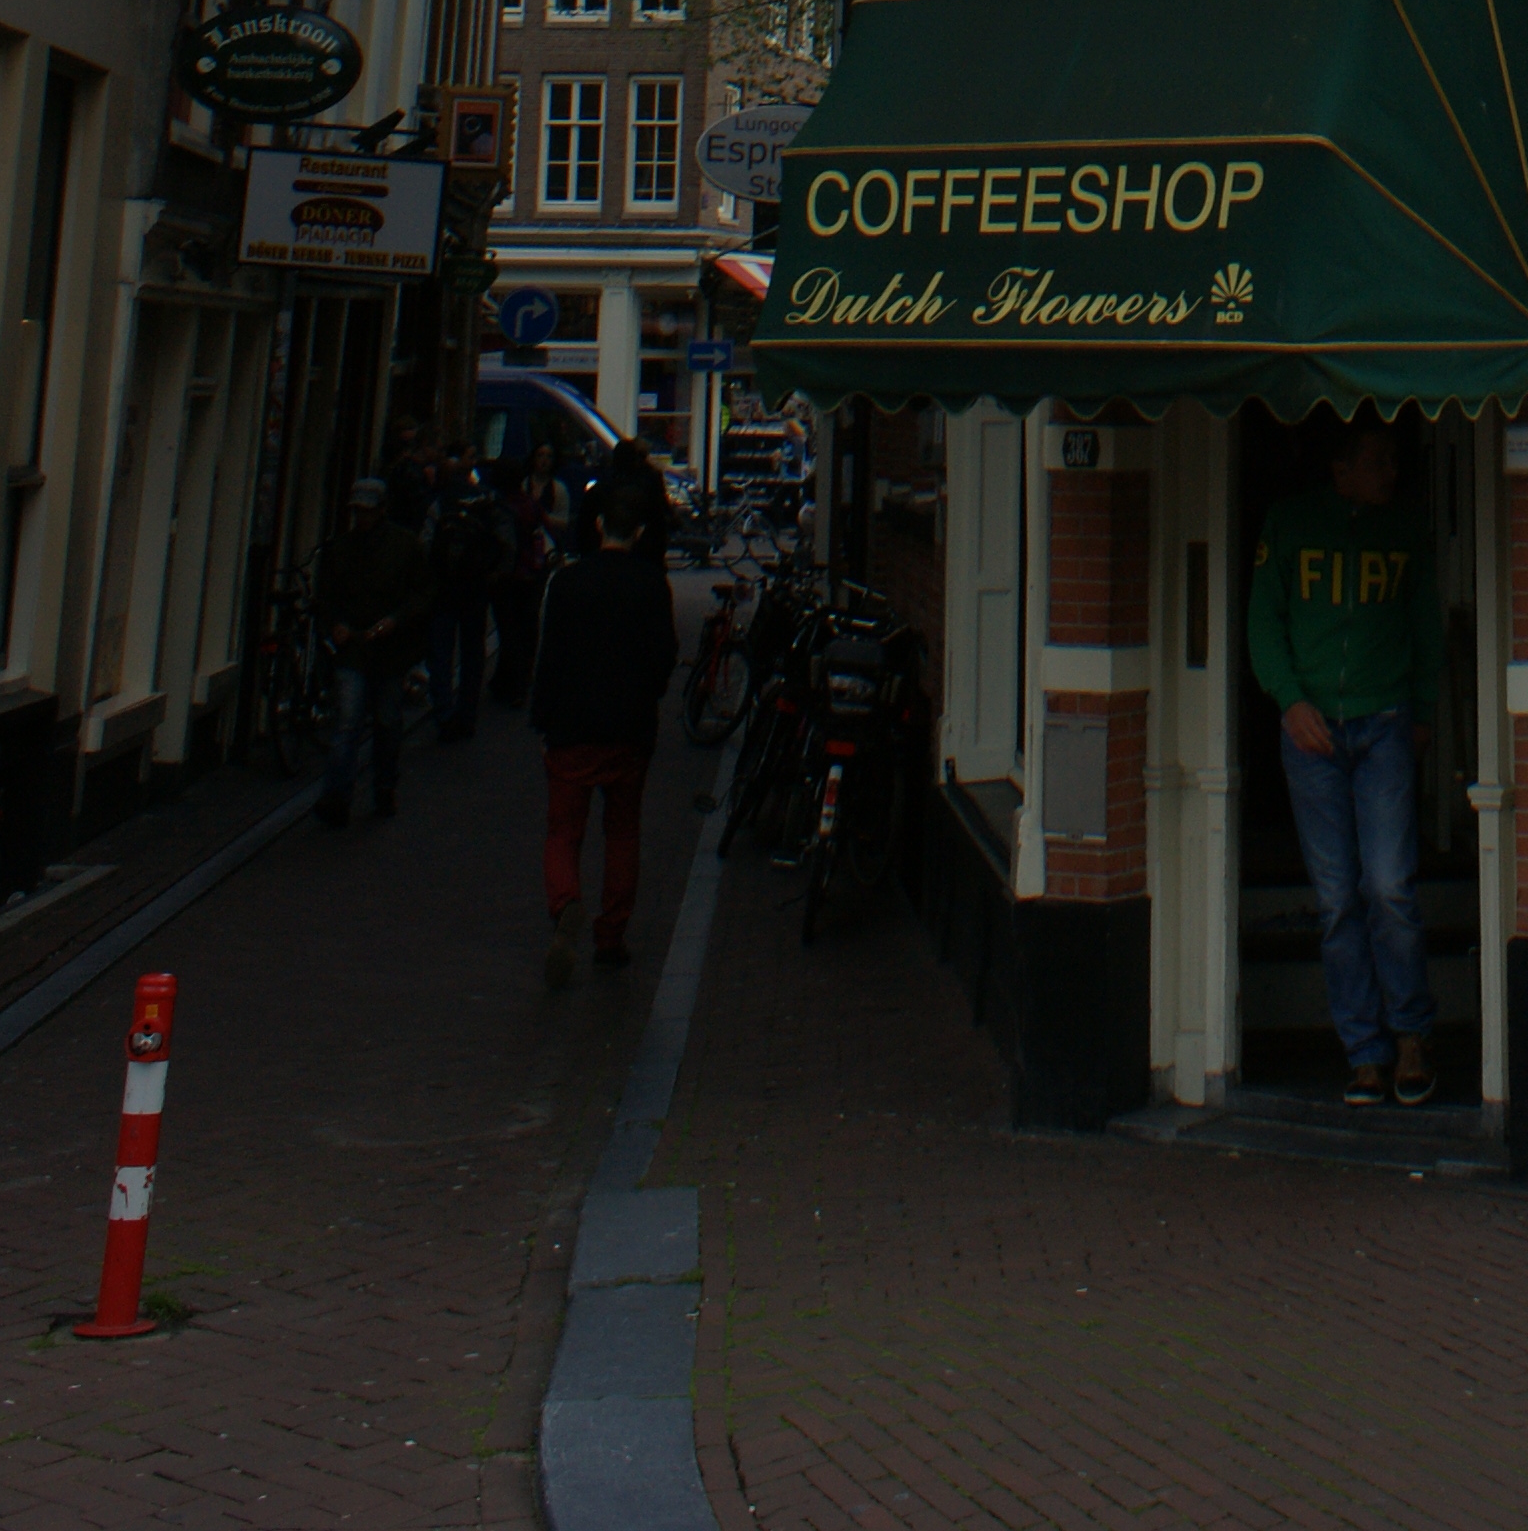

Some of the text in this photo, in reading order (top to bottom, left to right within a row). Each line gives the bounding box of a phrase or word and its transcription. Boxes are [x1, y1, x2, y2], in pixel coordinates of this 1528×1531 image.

[203, 13, 340, 53] Lanskroon
[299, 157, 389, 179] Restaurant
[302, 202, 373, 225] DÖNER
[805, 160, 1265, 238] COFFEESHOP
[300, 228, 372, 244] PALACE
[291, 246, 333, 264] KEBAB
[392, 253, 428, 270] PIZZA
[783, 264, 1205, 326] Dutch Flowers
[1299, 547, 1410, 606] FIAT
